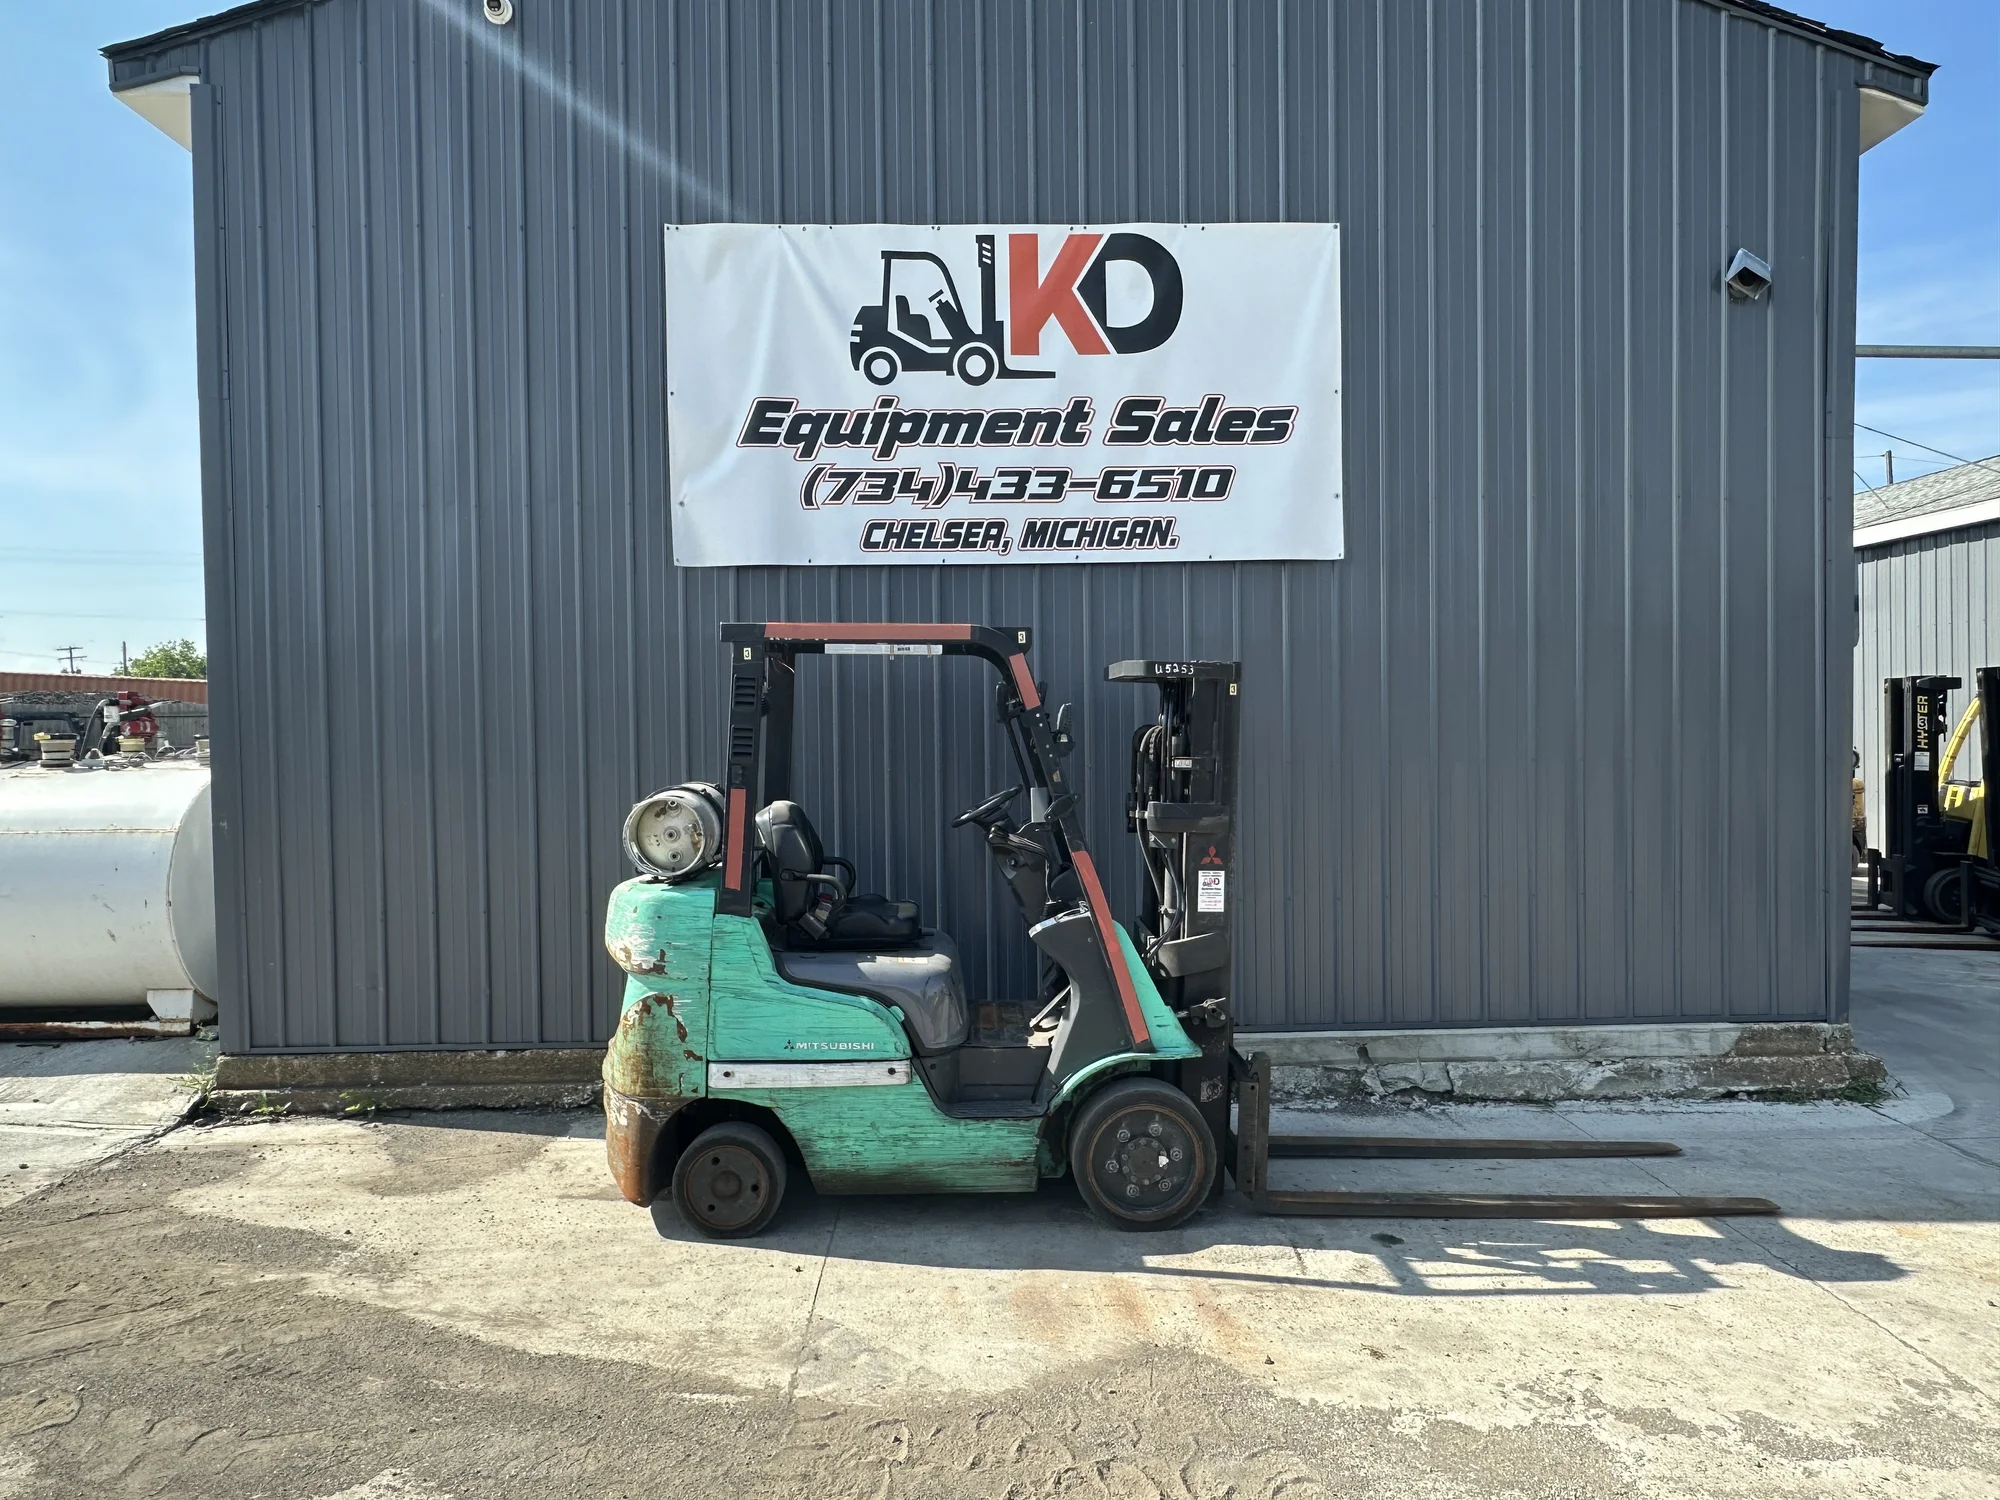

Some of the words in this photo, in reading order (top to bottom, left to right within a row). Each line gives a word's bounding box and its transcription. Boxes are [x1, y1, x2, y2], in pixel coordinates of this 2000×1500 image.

[1009, 233, 1184, 356] KD
[737, 395, 1096, 461] Equipment
[1105, 395, 1299, 447] Sales
[799, 462, 1238, 510] (734)433-6510
[859, 518, 1013, 556] CHELSEA,
[1018, 516, 1181, 550] MICHIGAN.
[1917, 695, 1929, 749] HYTER
[796, 1042, 875, 1050] MITSUBISHI
